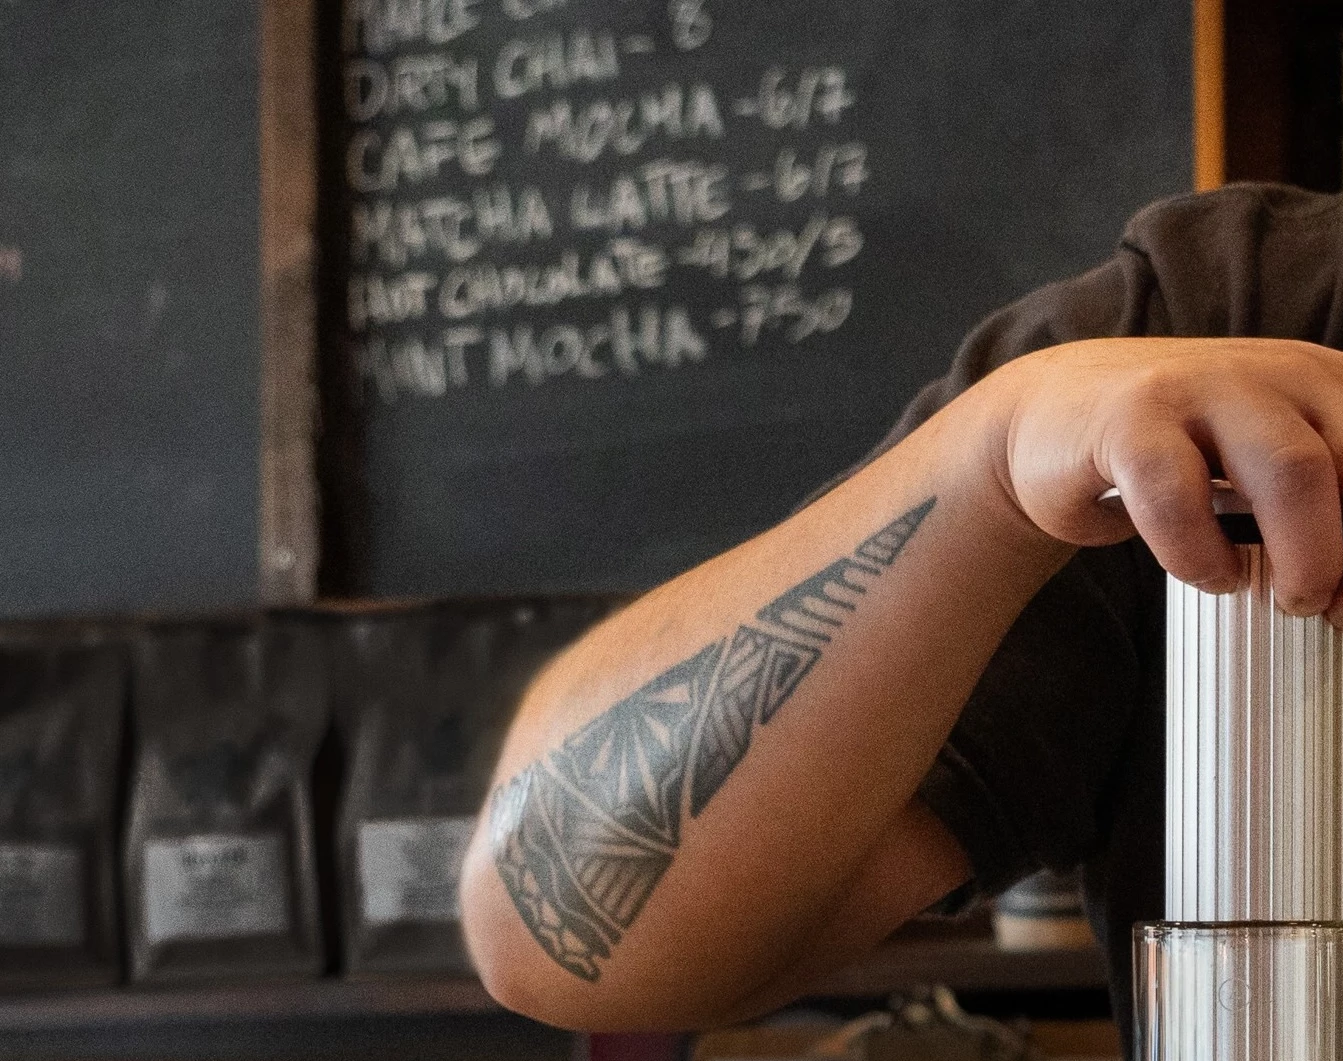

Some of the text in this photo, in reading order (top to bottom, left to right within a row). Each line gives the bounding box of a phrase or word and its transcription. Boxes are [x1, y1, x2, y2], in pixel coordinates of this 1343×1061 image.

[343, 54, 478, 120] DIRTY
[346, 116, 502, 192] CAFE
[523, 82, 725, 164] MOCHA
[348, 185, 554, 267] MATCHA
[570, 158, 733, 231] LATTE
[487, 306, 708, 388] MOCHA
